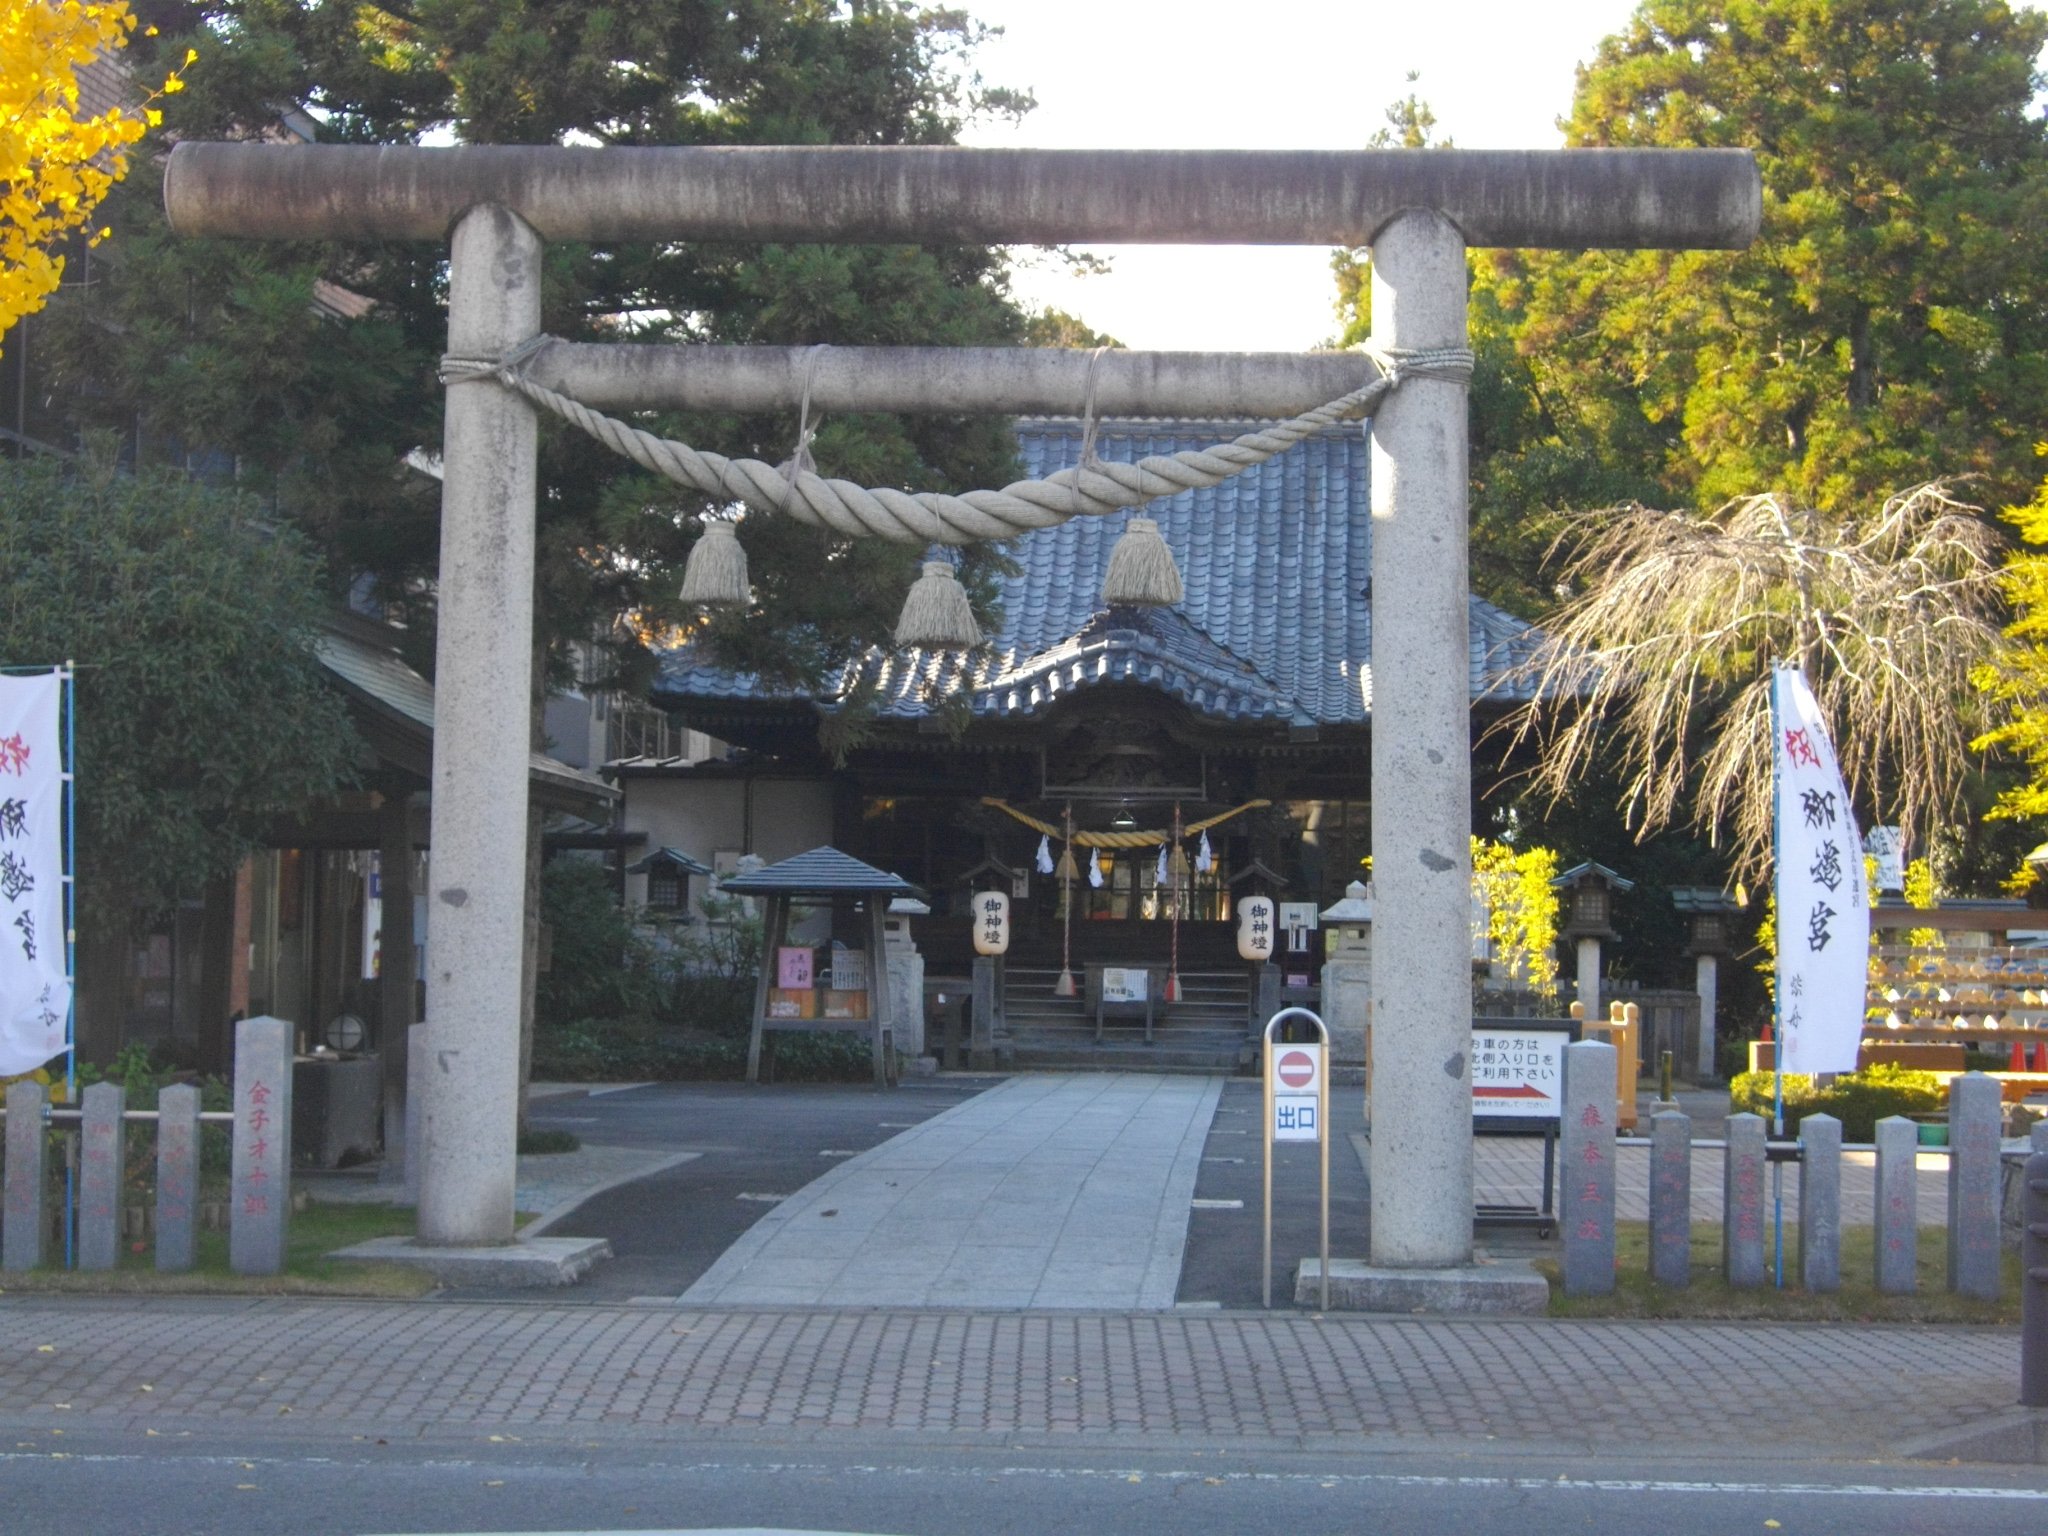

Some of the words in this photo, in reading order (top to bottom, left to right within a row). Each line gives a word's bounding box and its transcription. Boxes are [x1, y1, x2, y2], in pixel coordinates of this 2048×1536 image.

[1472, 1038, 1538, 1050] お車の方は
[1472, 1053, 1554, 1065] 北側入り口を
[1472, 1067, 1555, 1080] ご利用下さい
[1278, 1105, 1315, 1129] 出口
